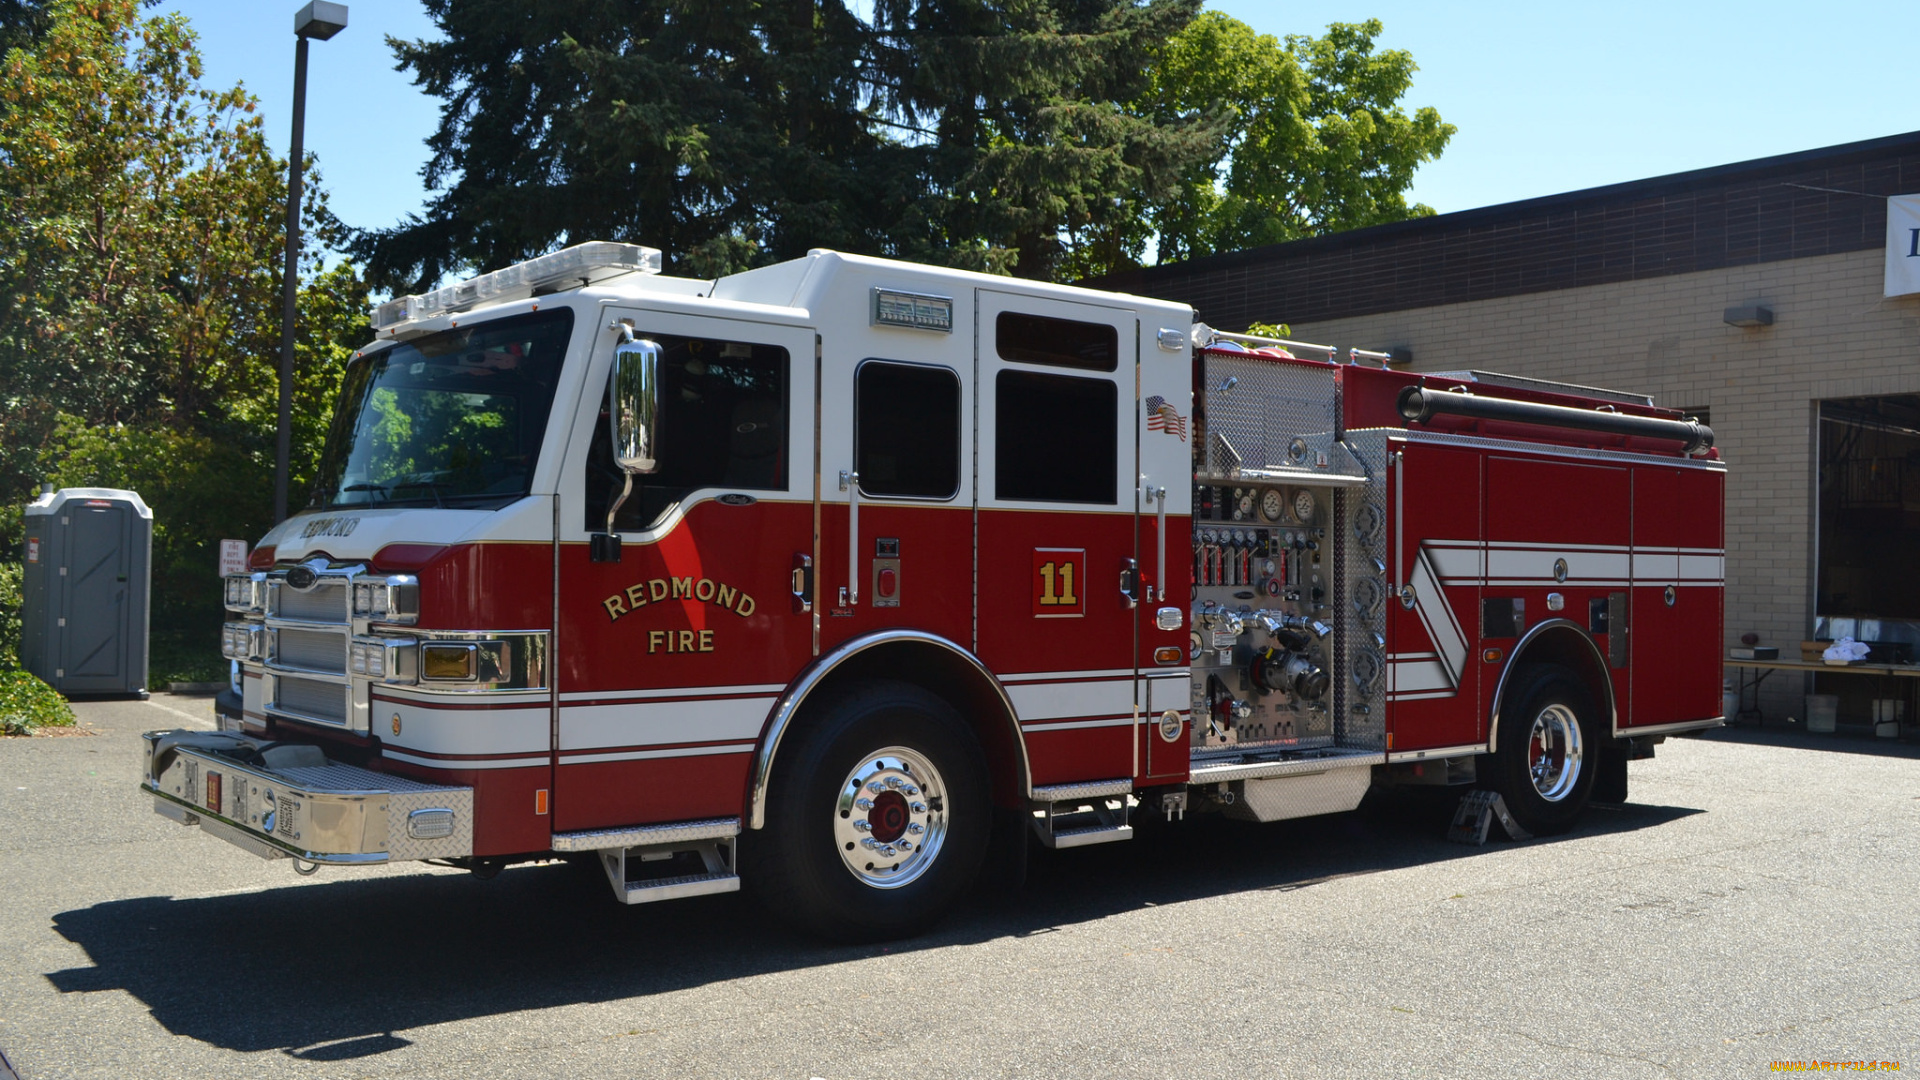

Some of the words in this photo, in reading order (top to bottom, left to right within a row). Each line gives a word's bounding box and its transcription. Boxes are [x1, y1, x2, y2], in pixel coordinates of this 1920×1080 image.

[603, 576, 756, 621] REDMOND
[1039, 562, 1077, 605] 11
[647, 630, 714, 654] FIRE
